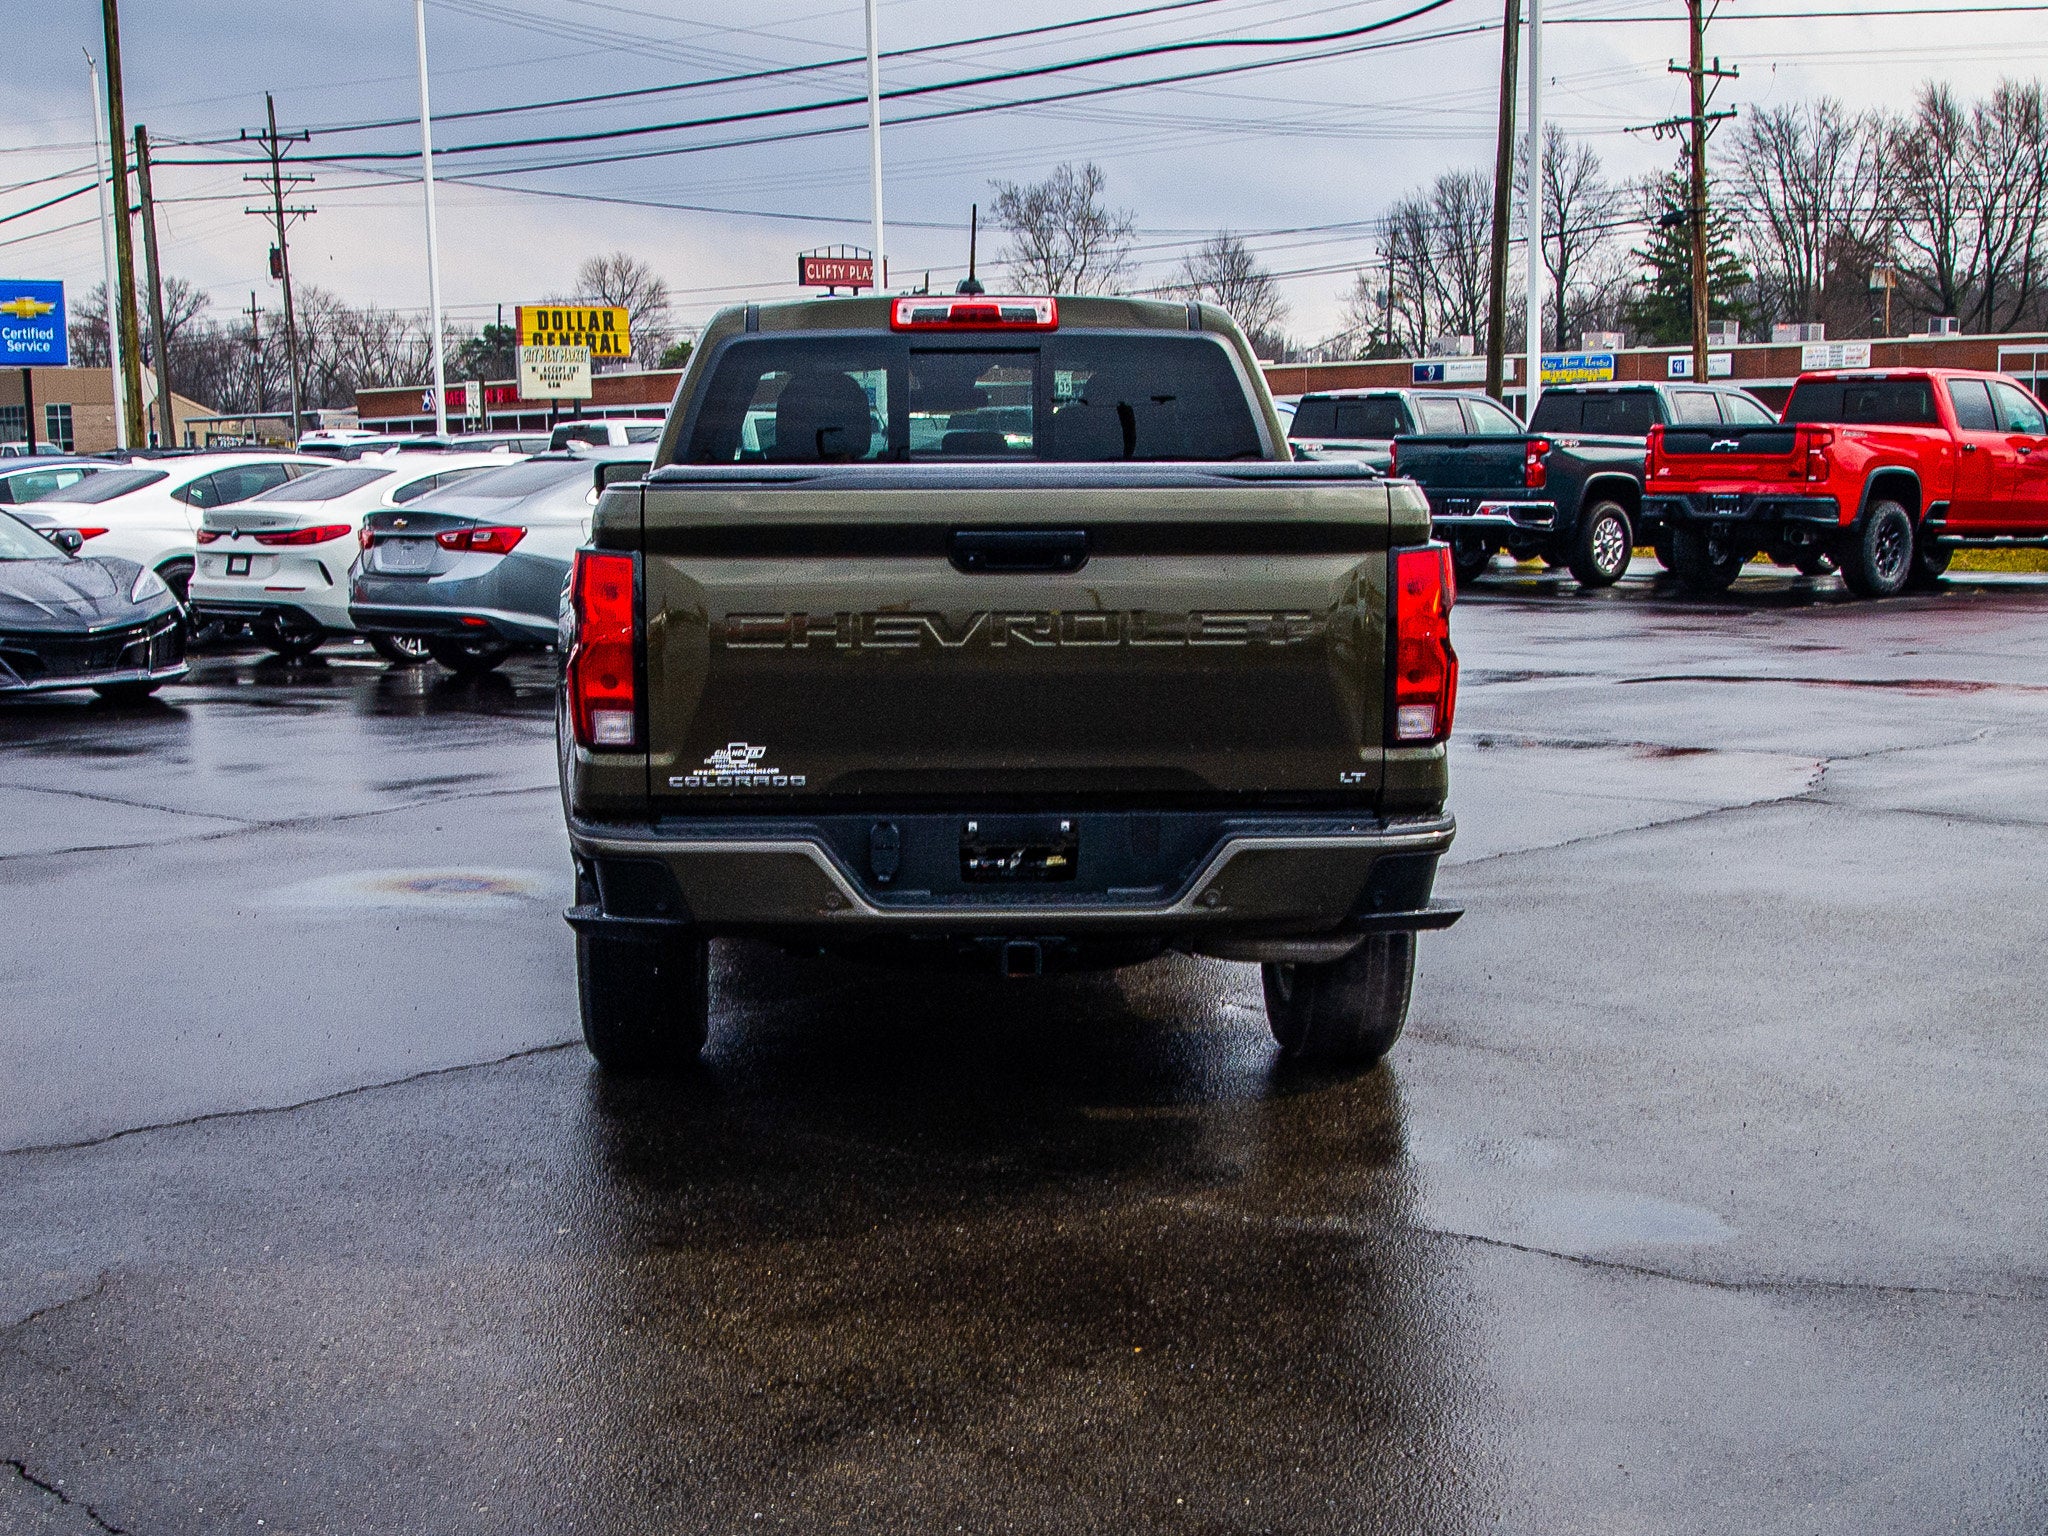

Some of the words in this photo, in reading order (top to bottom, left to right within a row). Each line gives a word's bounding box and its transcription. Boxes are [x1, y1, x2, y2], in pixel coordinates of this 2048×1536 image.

[807, 264, 845, 279] CLIFTY
[850, 265, 874, 280] PLA
[537, 310, 615, 331] DOLLAR
[2, 327, 54, 340] Certified
[7, 340, 51, 353] Service
[532, 332, 622, 353] GENERAL
[725, 611, 1311, 648] CHEVROLET
[669, 775, 806, 787] COLORADO
[1340, 772, 1367, 783] LT
